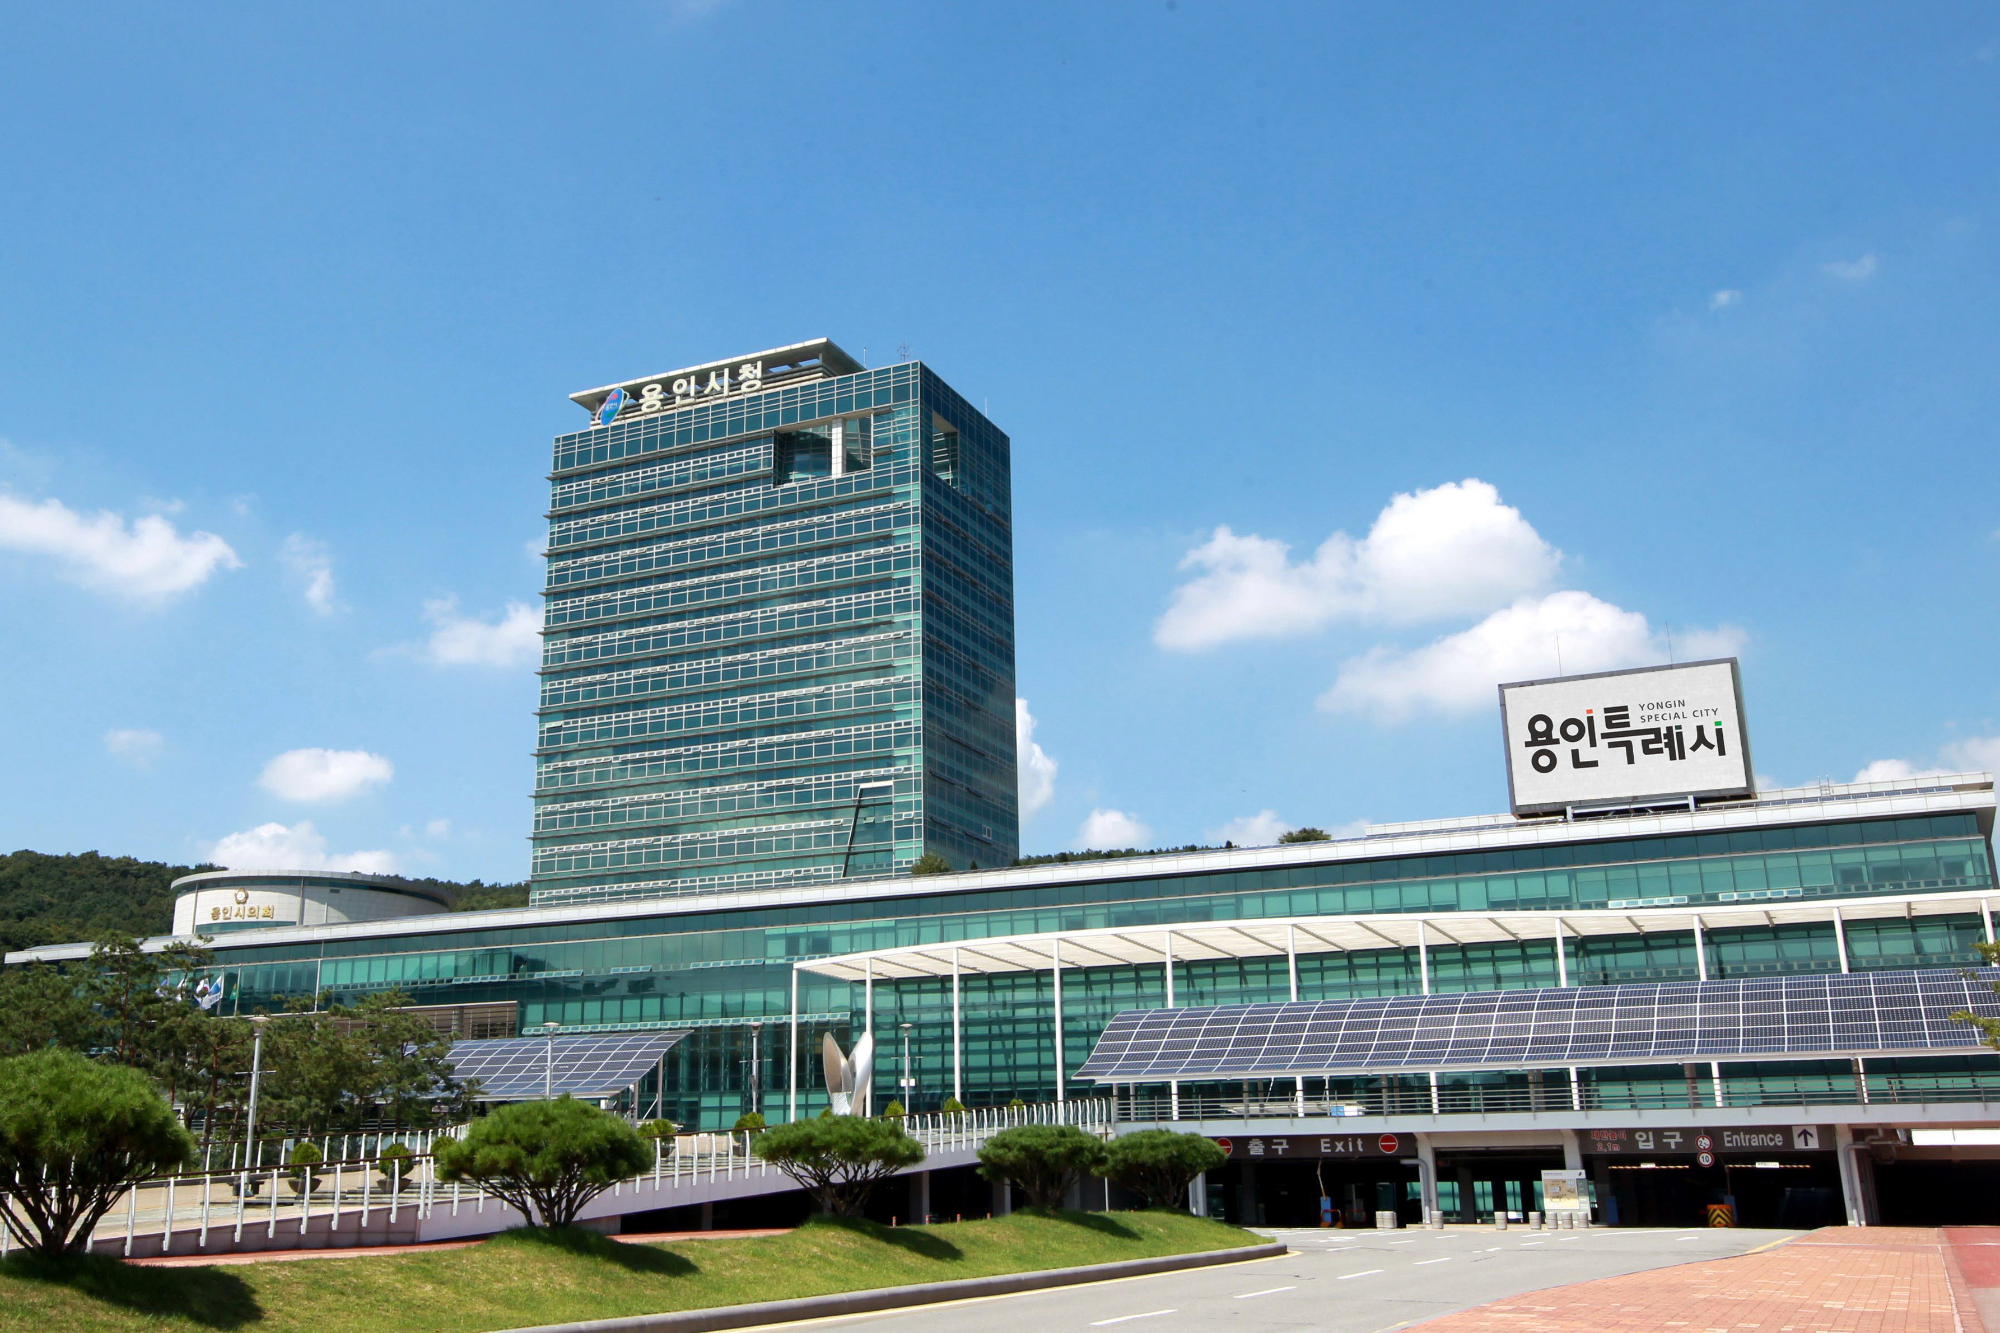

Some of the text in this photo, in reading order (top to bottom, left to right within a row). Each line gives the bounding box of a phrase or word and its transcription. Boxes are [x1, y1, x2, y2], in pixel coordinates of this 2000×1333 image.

[639, 361, 763, 413] 용인시청
[1639, 699, 1686, 712] YONGIN
[1640, 707, 1719, 723] SPECIAL CITY
[1524, 705, 1726, 773] 용인특례시
[211, 905, 274, 920] 용인시의회
[1320, 1137, 1363, 1153] Exit
[1634, 1131, 1683, 1149] 입구
[1723, 1131, 1783, 1147] Entrance
[1701, 1155, 1710, 1163] 10
